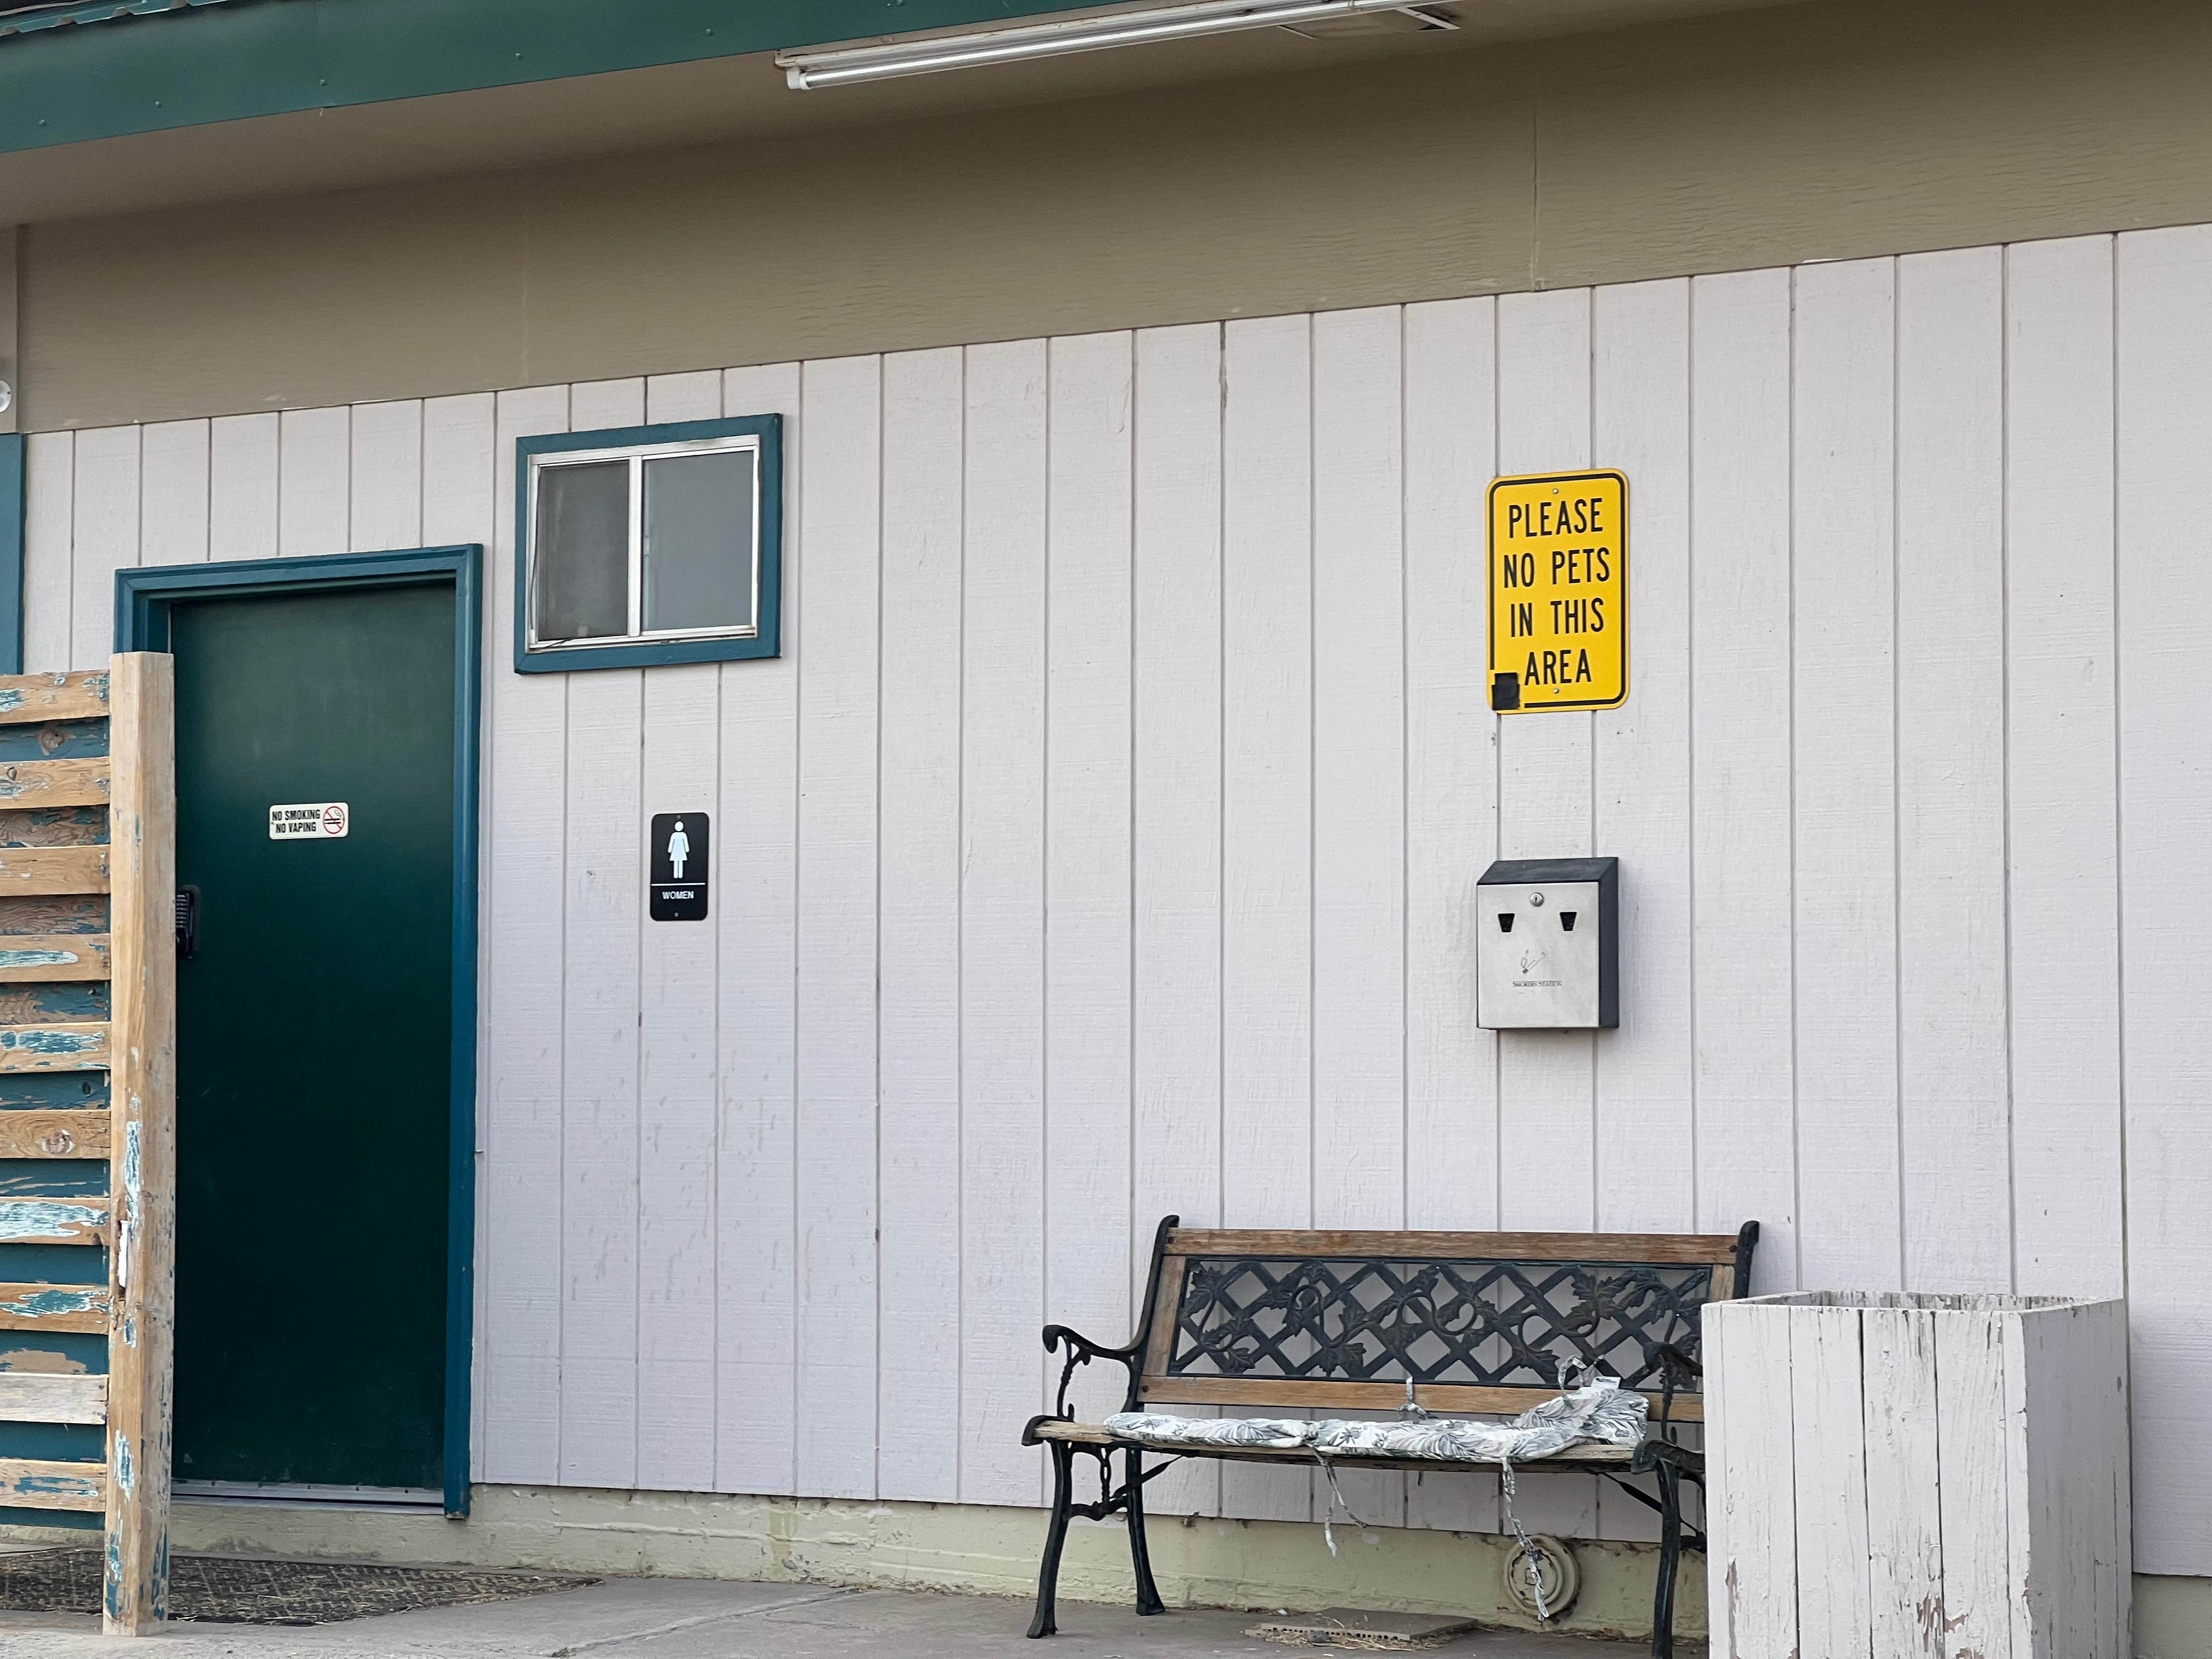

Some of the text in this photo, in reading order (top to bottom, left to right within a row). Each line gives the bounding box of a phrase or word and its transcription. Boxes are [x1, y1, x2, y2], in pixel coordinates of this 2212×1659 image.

[1509, 498, 1602, 539] PLEASE
[1504, 548, 1610, 588] NO PETS
[1511, 597, 1604, 637] IN THIS
[1524, 648, 1592, 686] AREA
[272, 809, 320, 821] NO SMOKING
[276, 822, 317, 833] NO VAPING
[662, 891, 694, 899] WOMEN
